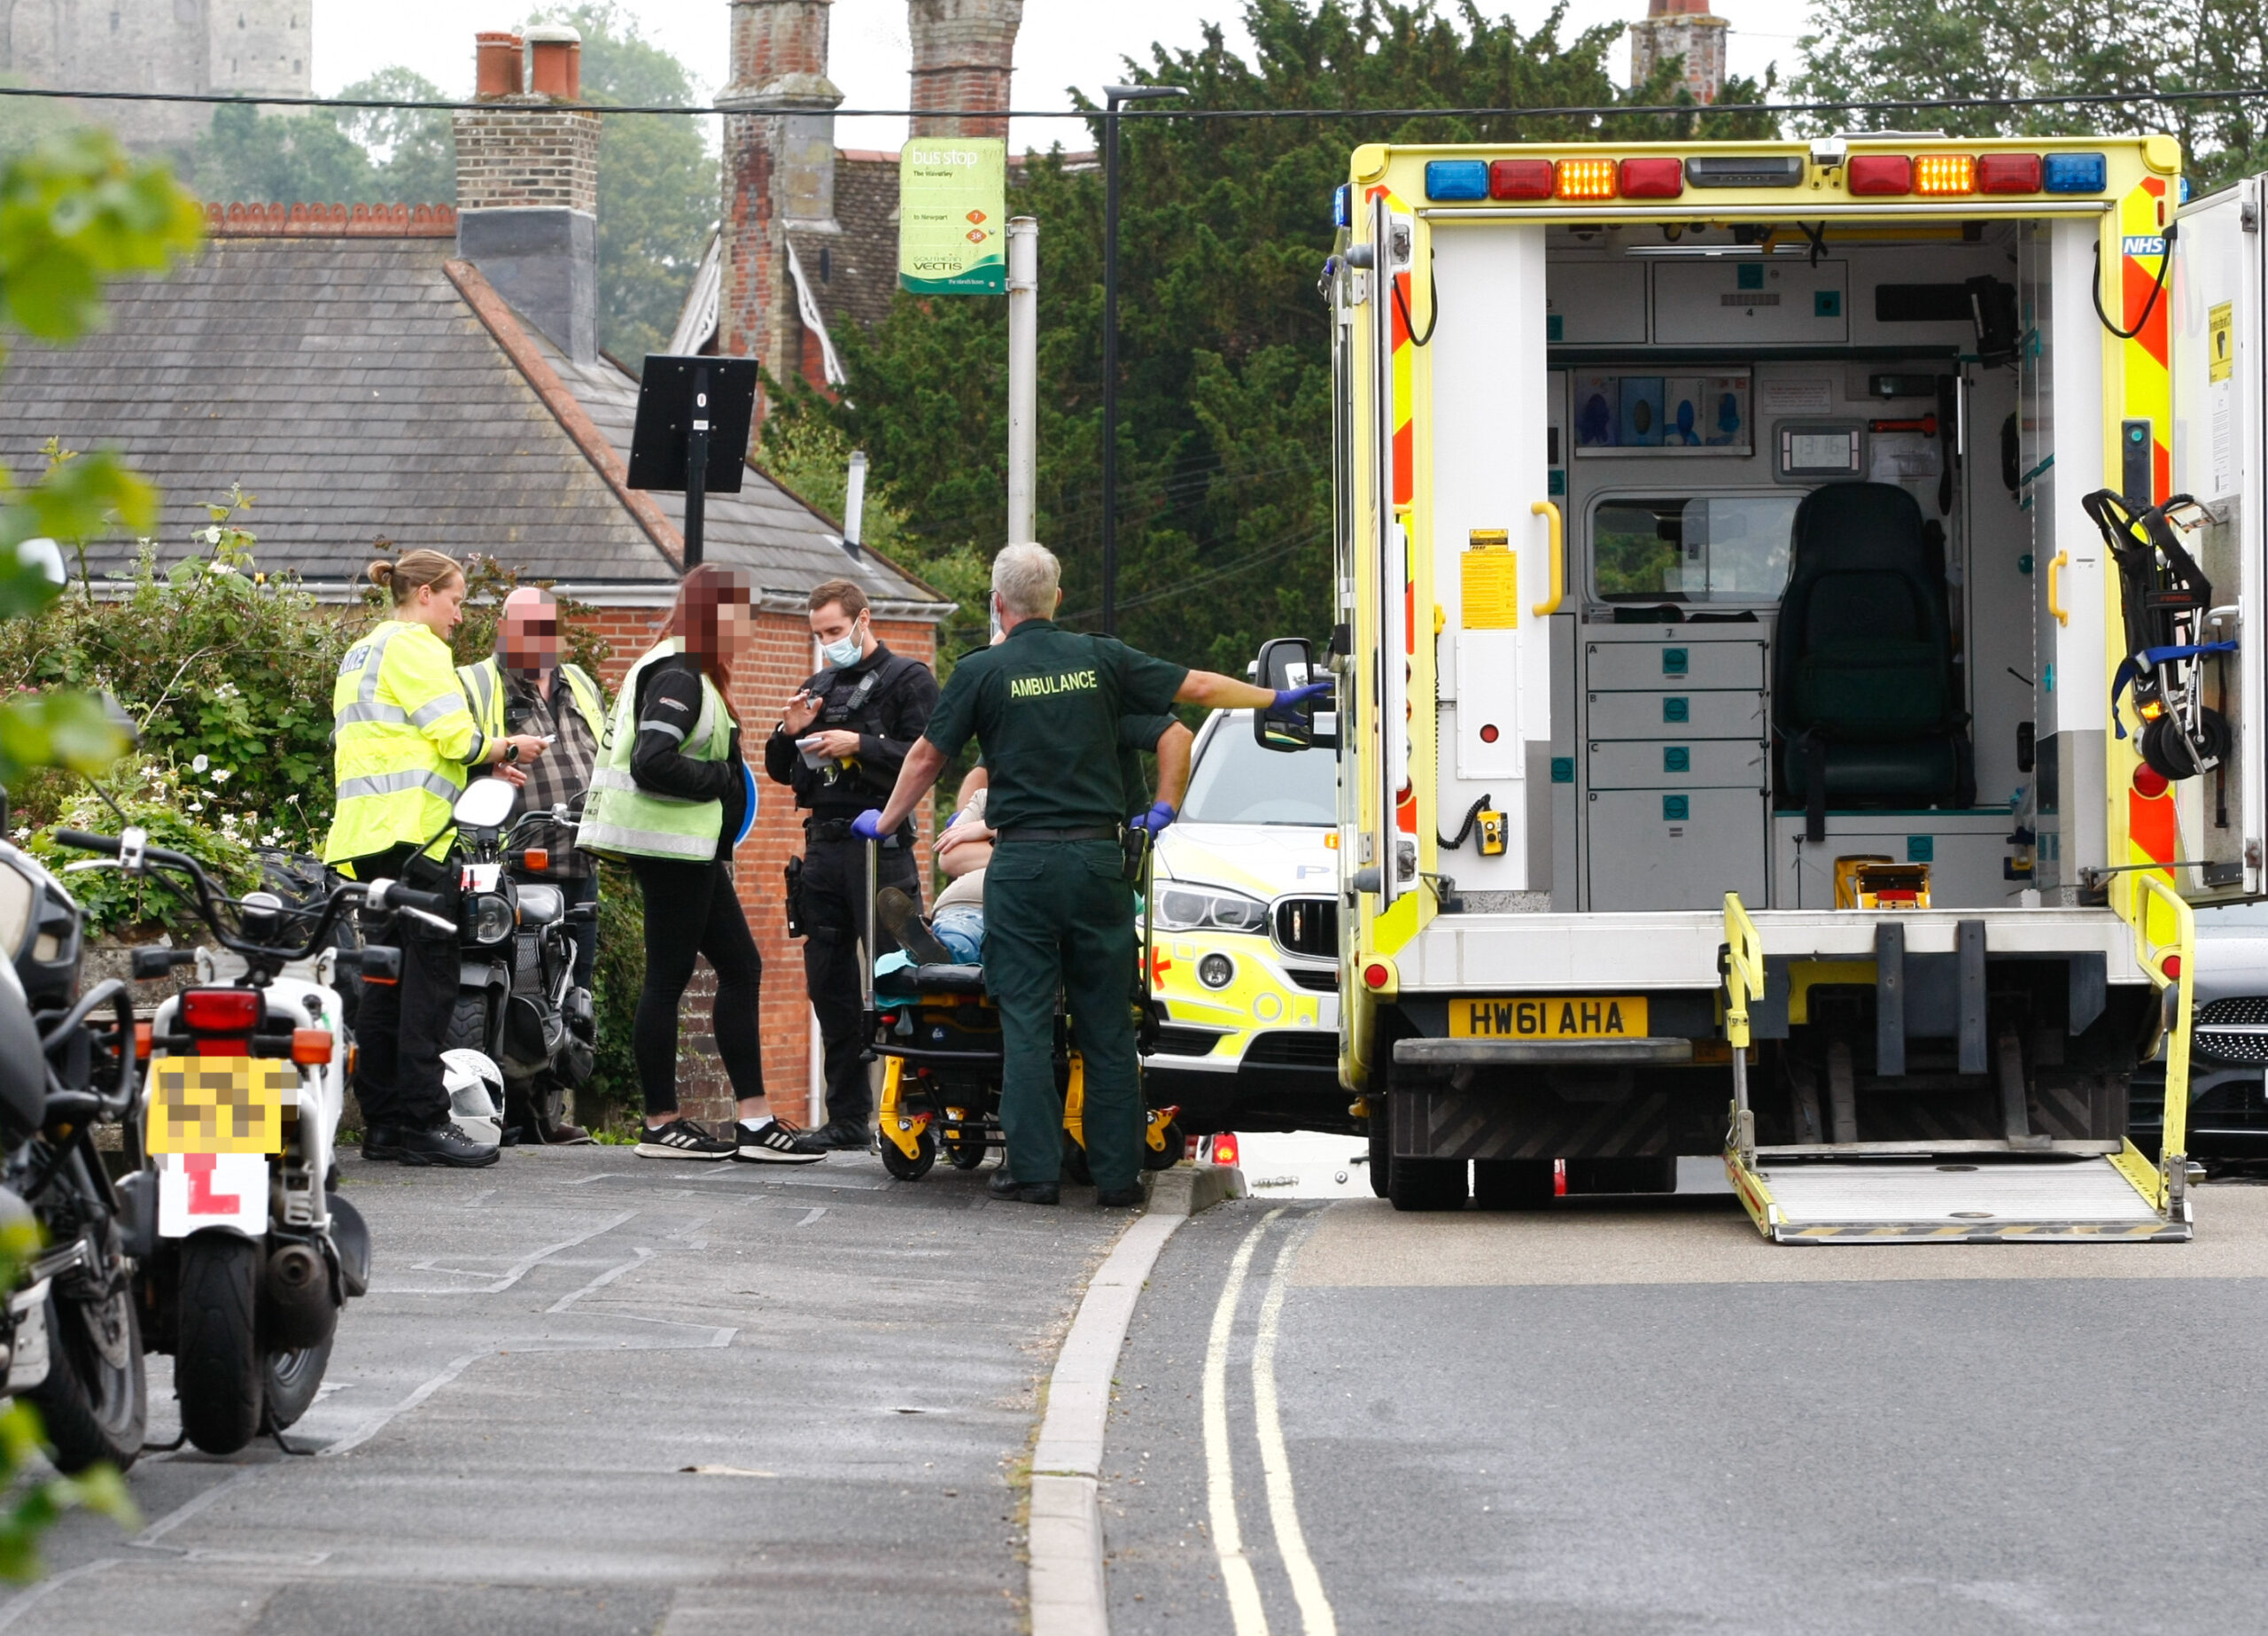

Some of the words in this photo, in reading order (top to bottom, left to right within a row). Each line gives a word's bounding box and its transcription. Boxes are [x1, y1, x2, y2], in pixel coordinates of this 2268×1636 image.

[913, 147, 941, 165] bus
[943, 149, 978, 169] stop
[2123, 237, 2163, 253] NHS
[913, 262, 963, 271] VECTIS
[1746, 308, 1754, 317] 4
[1666, 628, 1673, 637] 7
[1588, 645, 1597, 654] A
[1011, 671, 1098, 698] AMBULANCE
[1590, 743, 1599, 752] C
[1589, 793, 1598, 802] D
[1470, 1003, 1546, 1035] HW61
[1558, 1002, 1624, 1034] AHA
[184, 1153, 240, 1214] L
